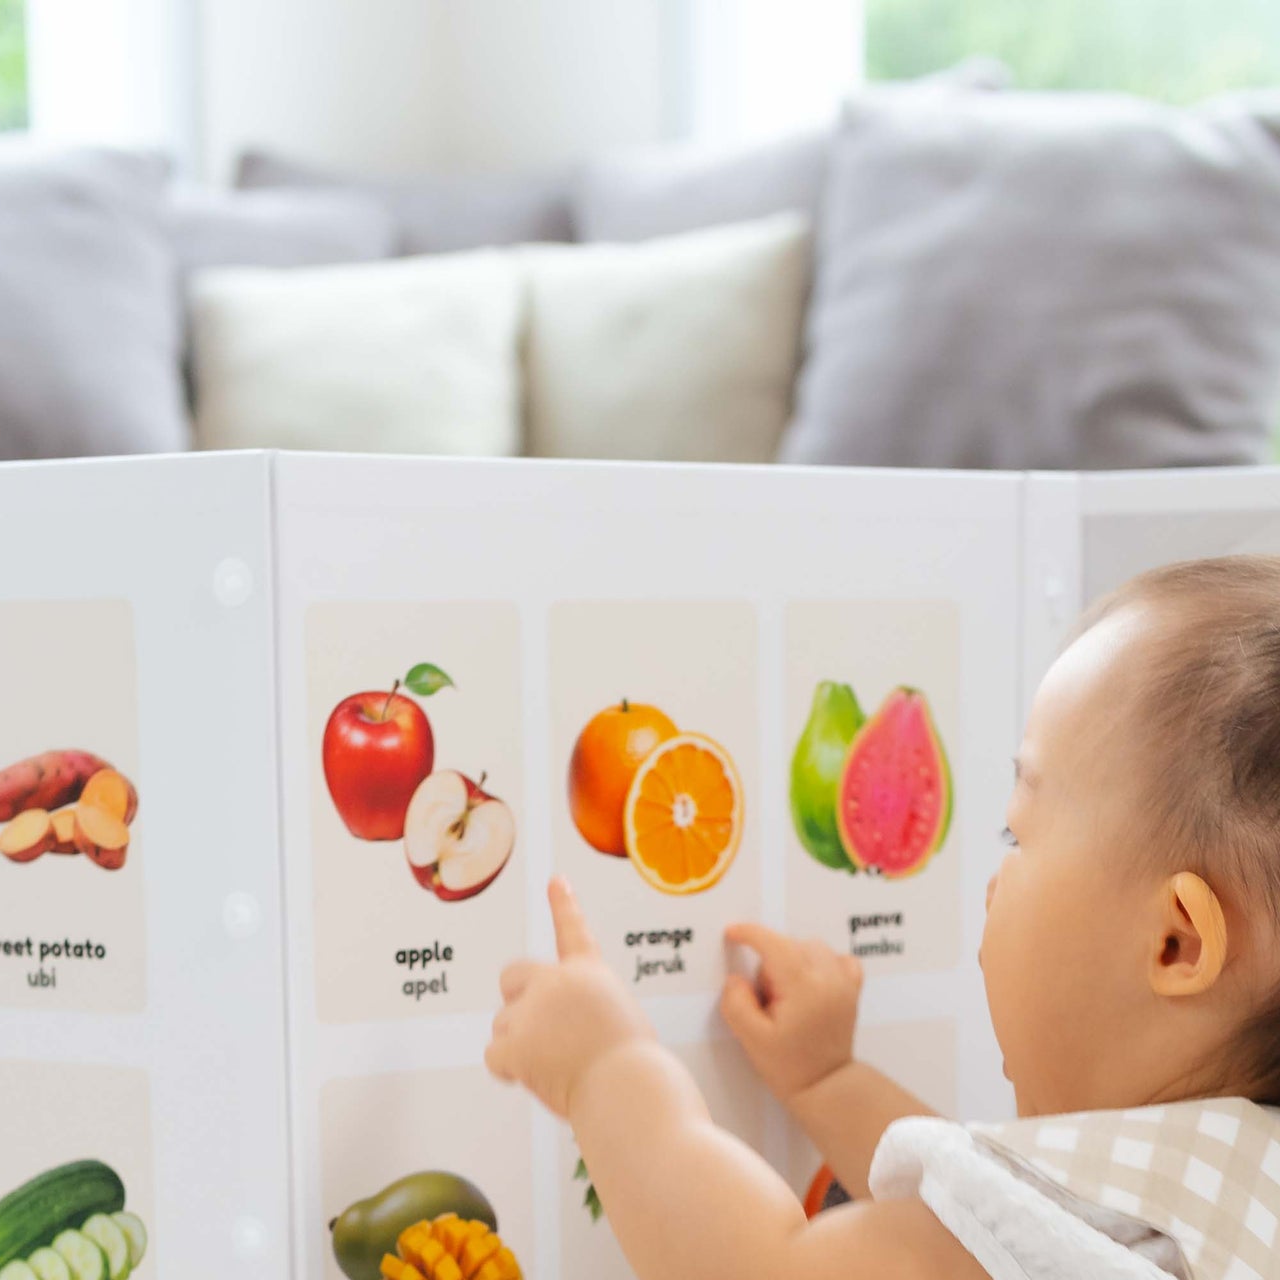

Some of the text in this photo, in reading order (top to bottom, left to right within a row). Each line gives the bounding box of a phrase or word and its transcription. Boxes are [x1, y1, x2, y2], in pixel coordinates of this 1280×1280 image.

[38, 938, 107, 963] potato
[624, 927, 694, 950] orange
[394, 940, 454, 971] apple
[633, 953, 686, 983] jeruk
[26, 966, 57, 989] ubi
[401, 970, 449, 1002] apel
